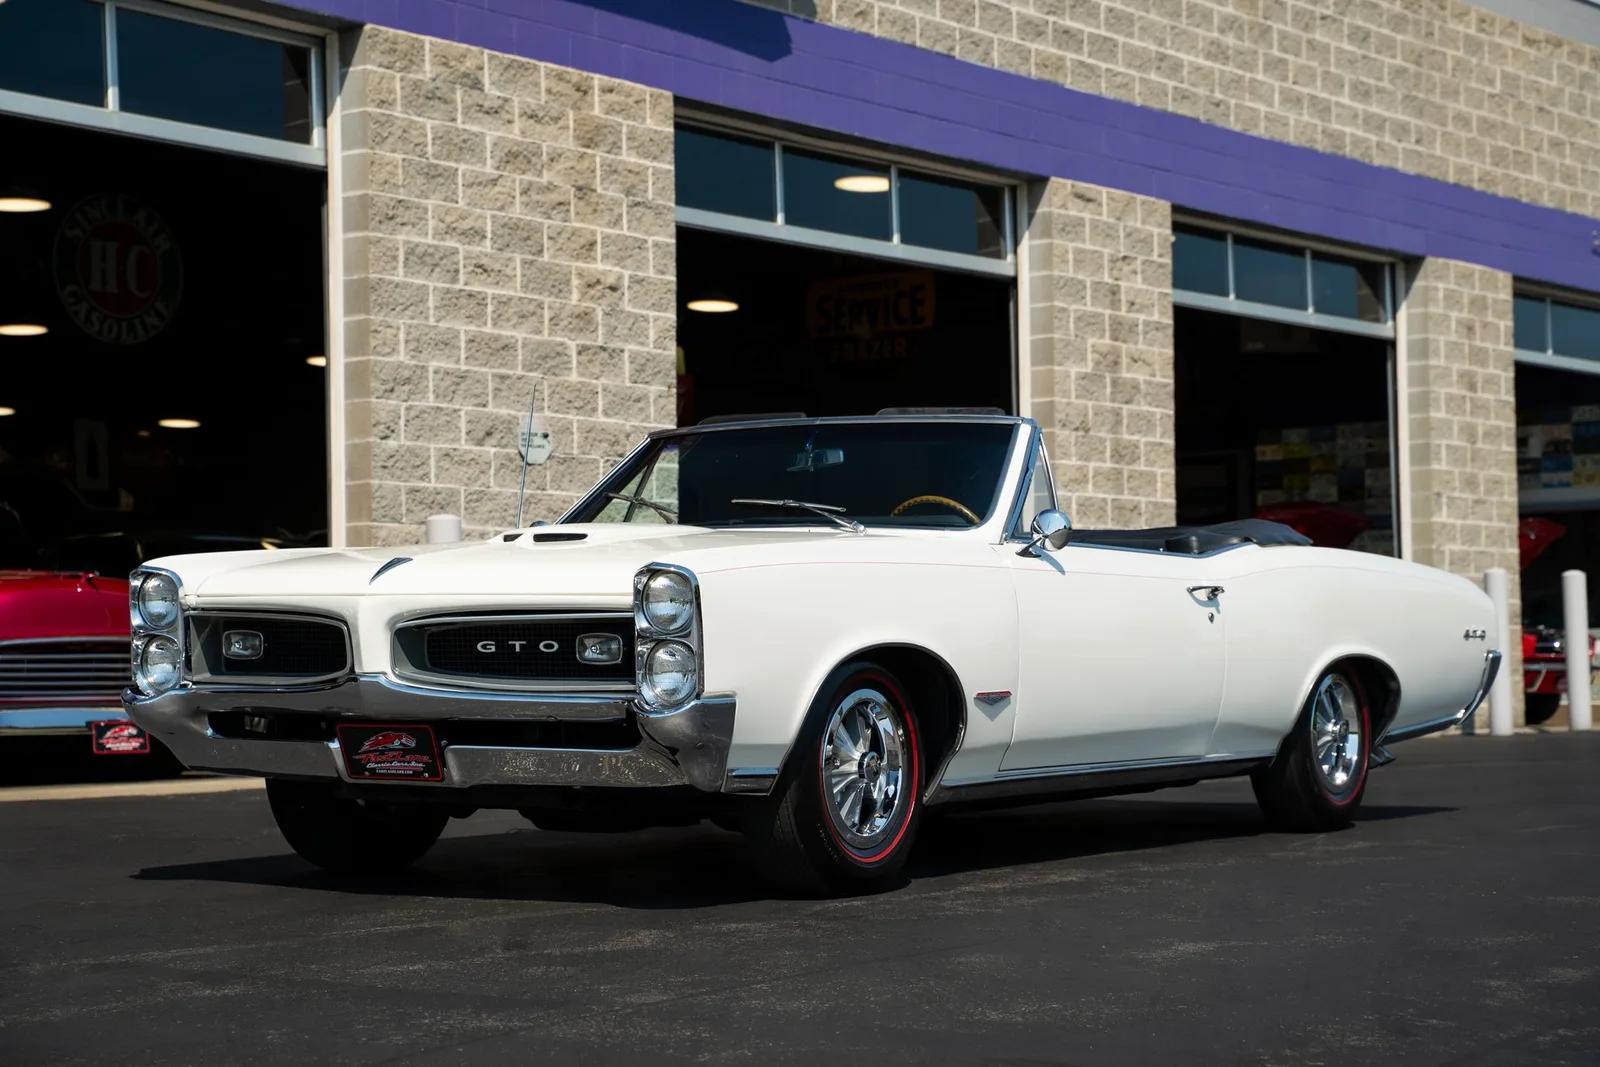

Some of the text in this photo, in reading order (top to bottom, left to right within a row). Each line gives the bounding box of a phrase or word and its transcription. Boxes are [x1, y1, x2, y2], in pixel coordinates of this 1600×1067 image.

[63, 284, 176, 341] GASOLINE
[814, 282, 928, 333] SERVICE
[476, 640, 560, 653] GTO
